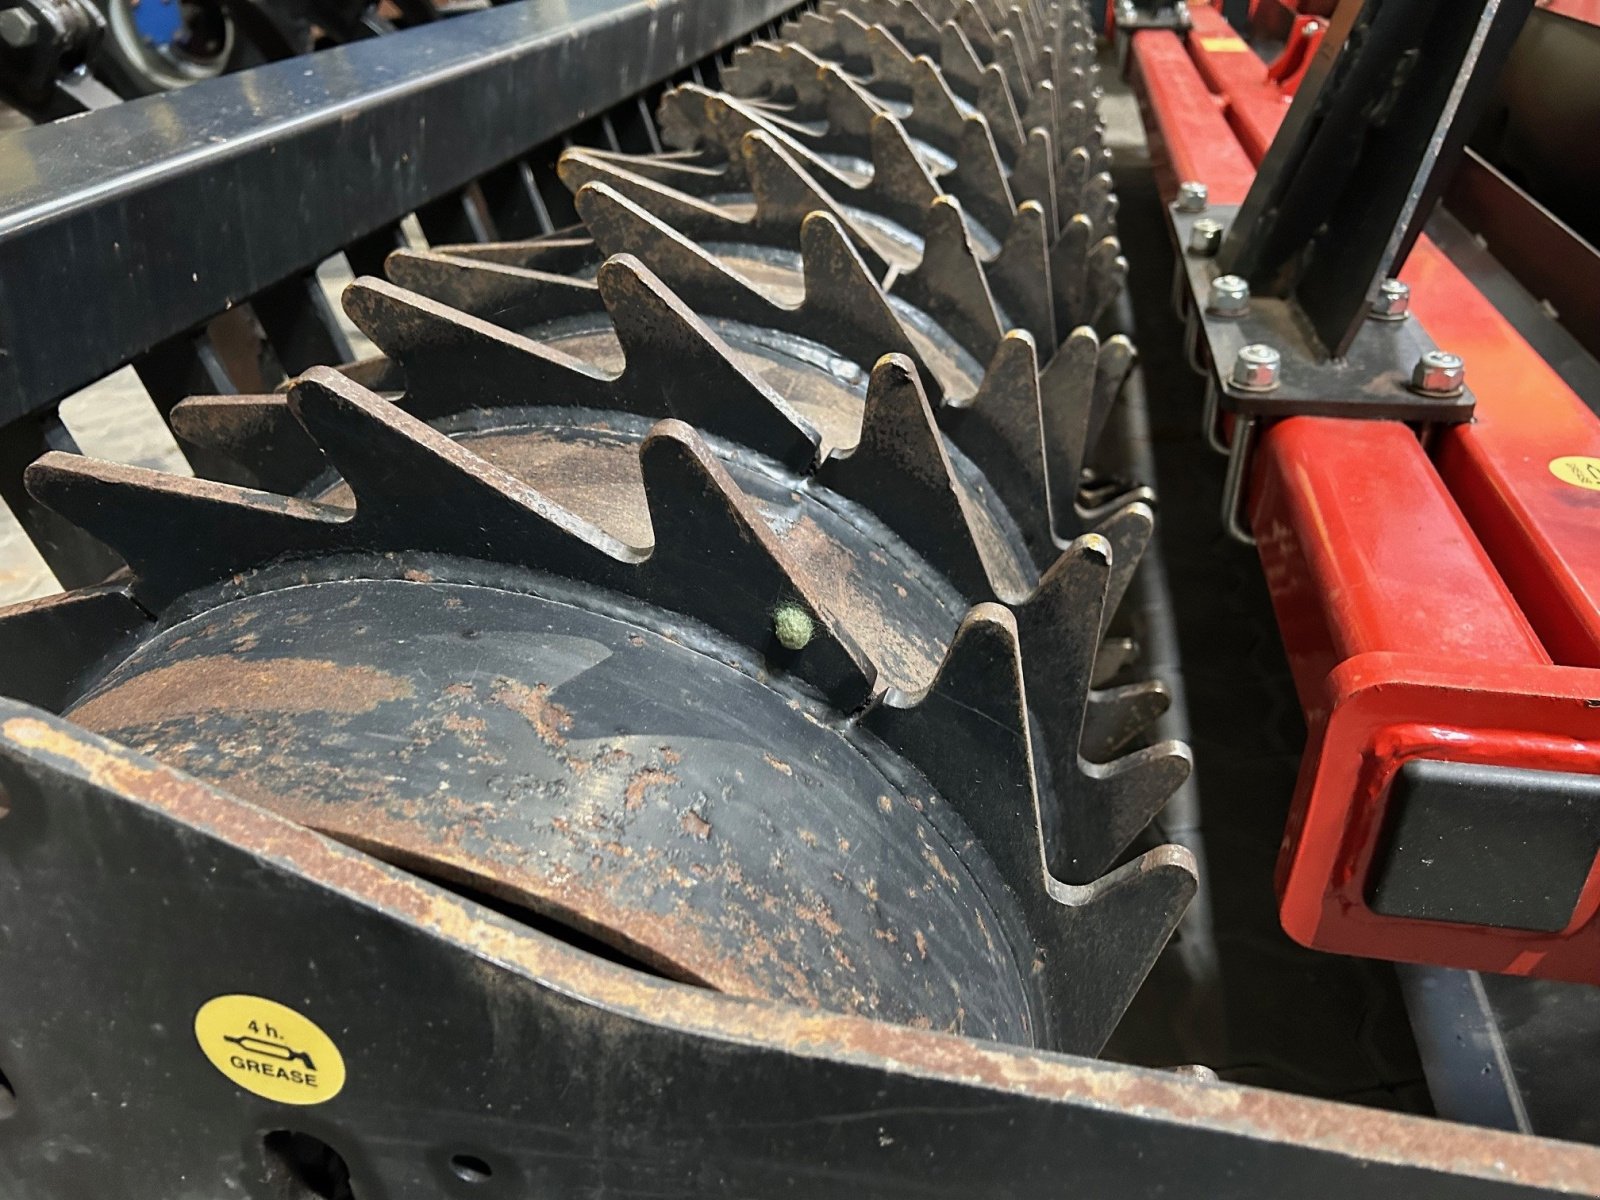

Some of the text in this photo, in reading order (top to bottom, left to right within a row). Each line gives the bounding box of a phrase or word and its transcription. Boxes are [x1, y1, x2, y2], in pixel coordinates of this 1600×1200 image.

[248, 1020, 284, 1040] 4 h.
[230, 1056, 318, 1088] GREASE
